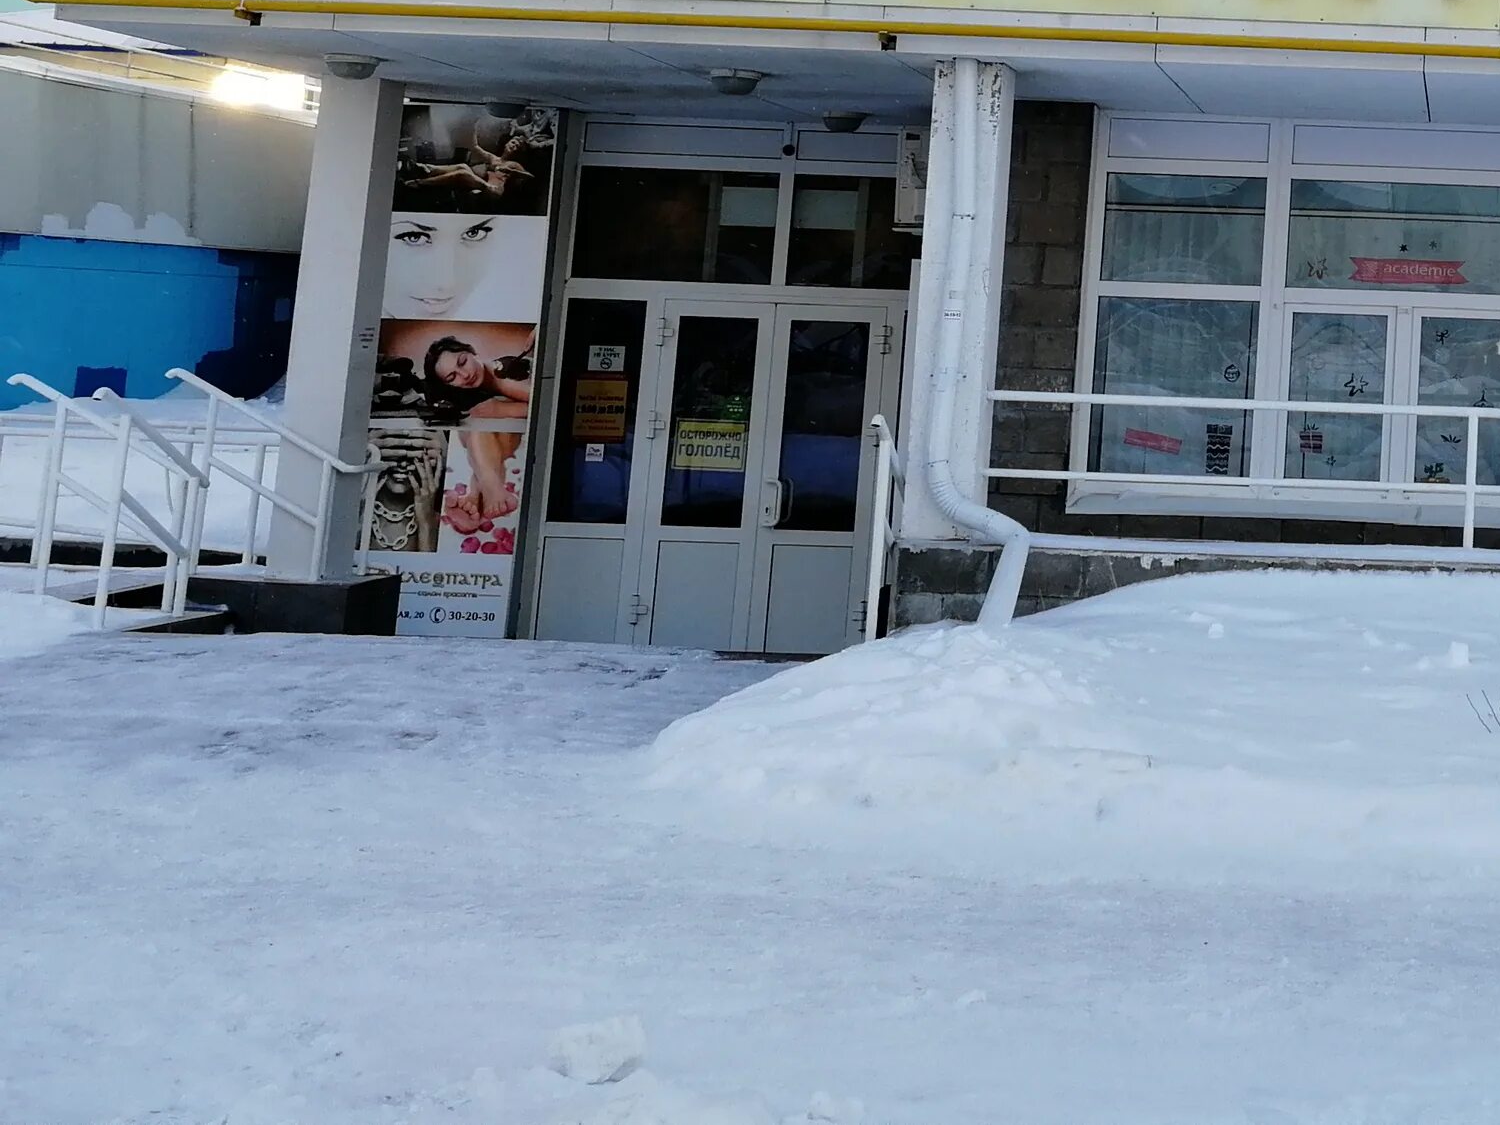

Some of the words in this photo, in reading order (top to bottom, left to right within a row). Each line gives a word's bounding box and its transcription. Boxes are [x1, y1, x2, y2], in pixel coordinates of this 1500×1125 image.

[679, 429, 742, 442] ОСТОРОЖНО
[678, 443, 741, 460] ГОЛОЛЁД
[448, 611, 496, 622] 30-20-30
